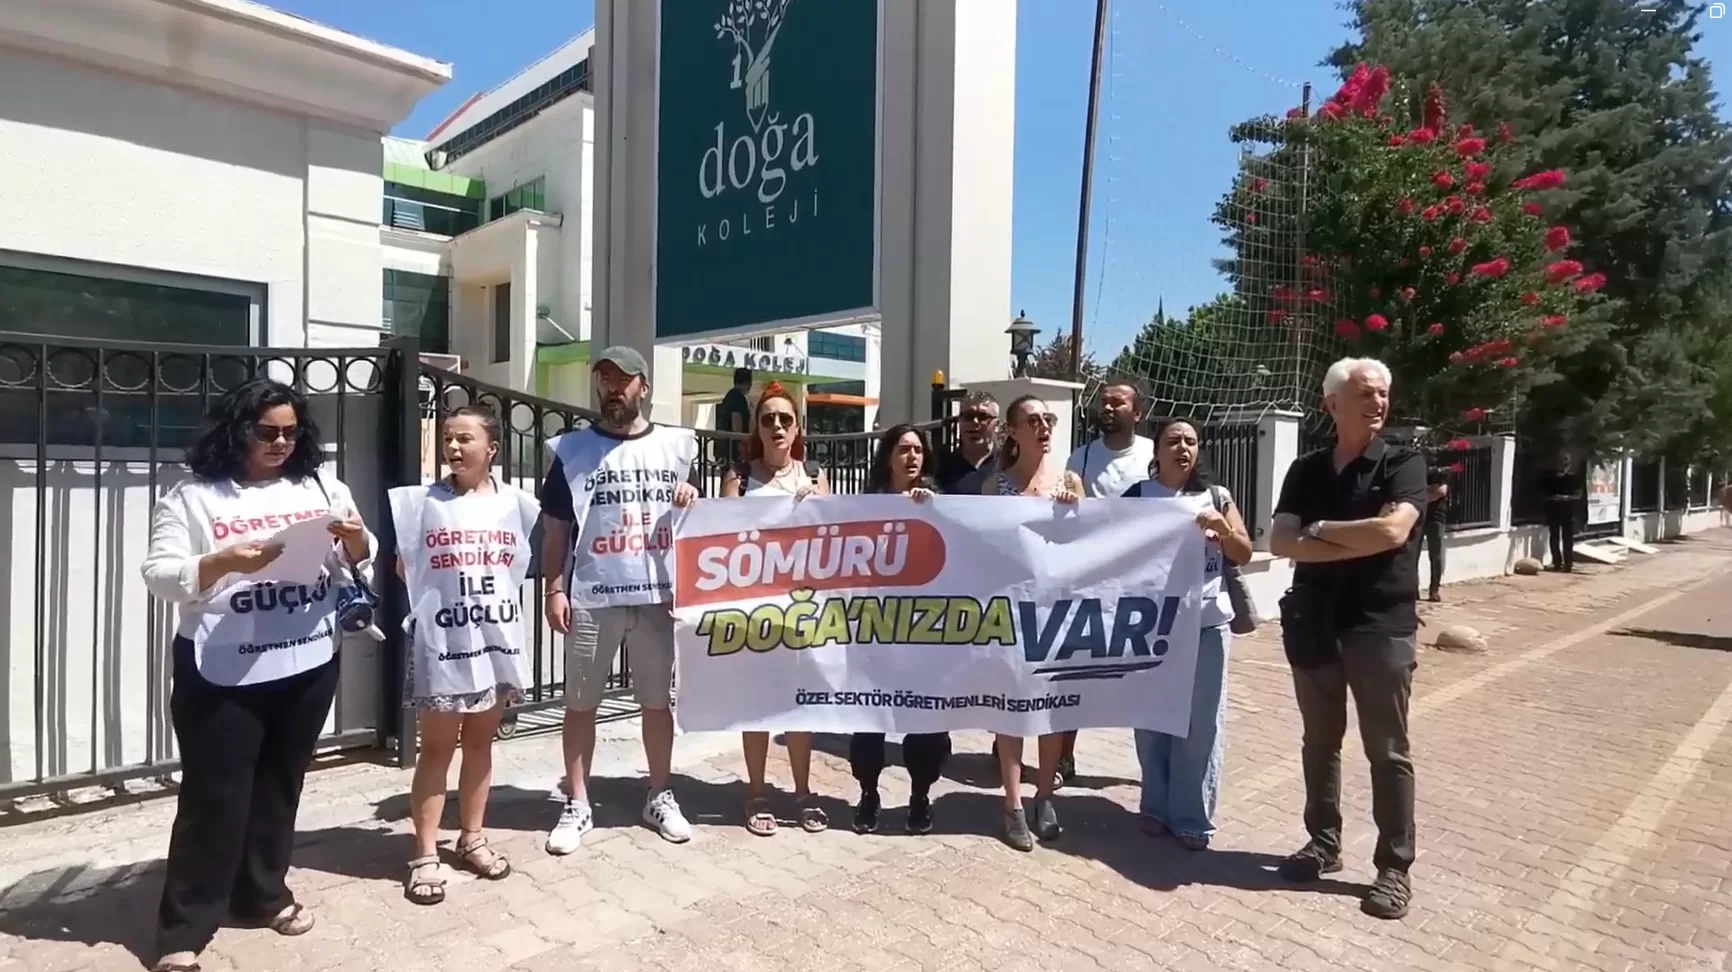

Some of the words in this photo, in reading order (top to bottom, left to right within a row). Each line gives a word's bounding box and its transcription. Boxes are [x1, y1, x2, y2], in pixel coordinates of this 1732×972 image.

[699, 111, 819, 203] doğa
[584, 468, 679, 492] ÖĞRETMEN
[622, 508, 651, 527] İLE
[426, 528, 517, 548] ÖĞRETMEN
[430, 547, 515, 569] SENDİKASI
[695, 522, 908, 591] SÖMÜRÜ
[459, 571, 495, 596] İLE
[435, 599, 519, 629] GÜÇLÜ!
[1018, 597, 1180, 662] VAR!
[796, 689, 832, 705] ÖZEL
[834, 689, 892, 707] SEKTÖR
[893, 690, 1006, 711] ÖĞRETMENLERİ
[1007, 693, 1081, 713] SENDİKASI
